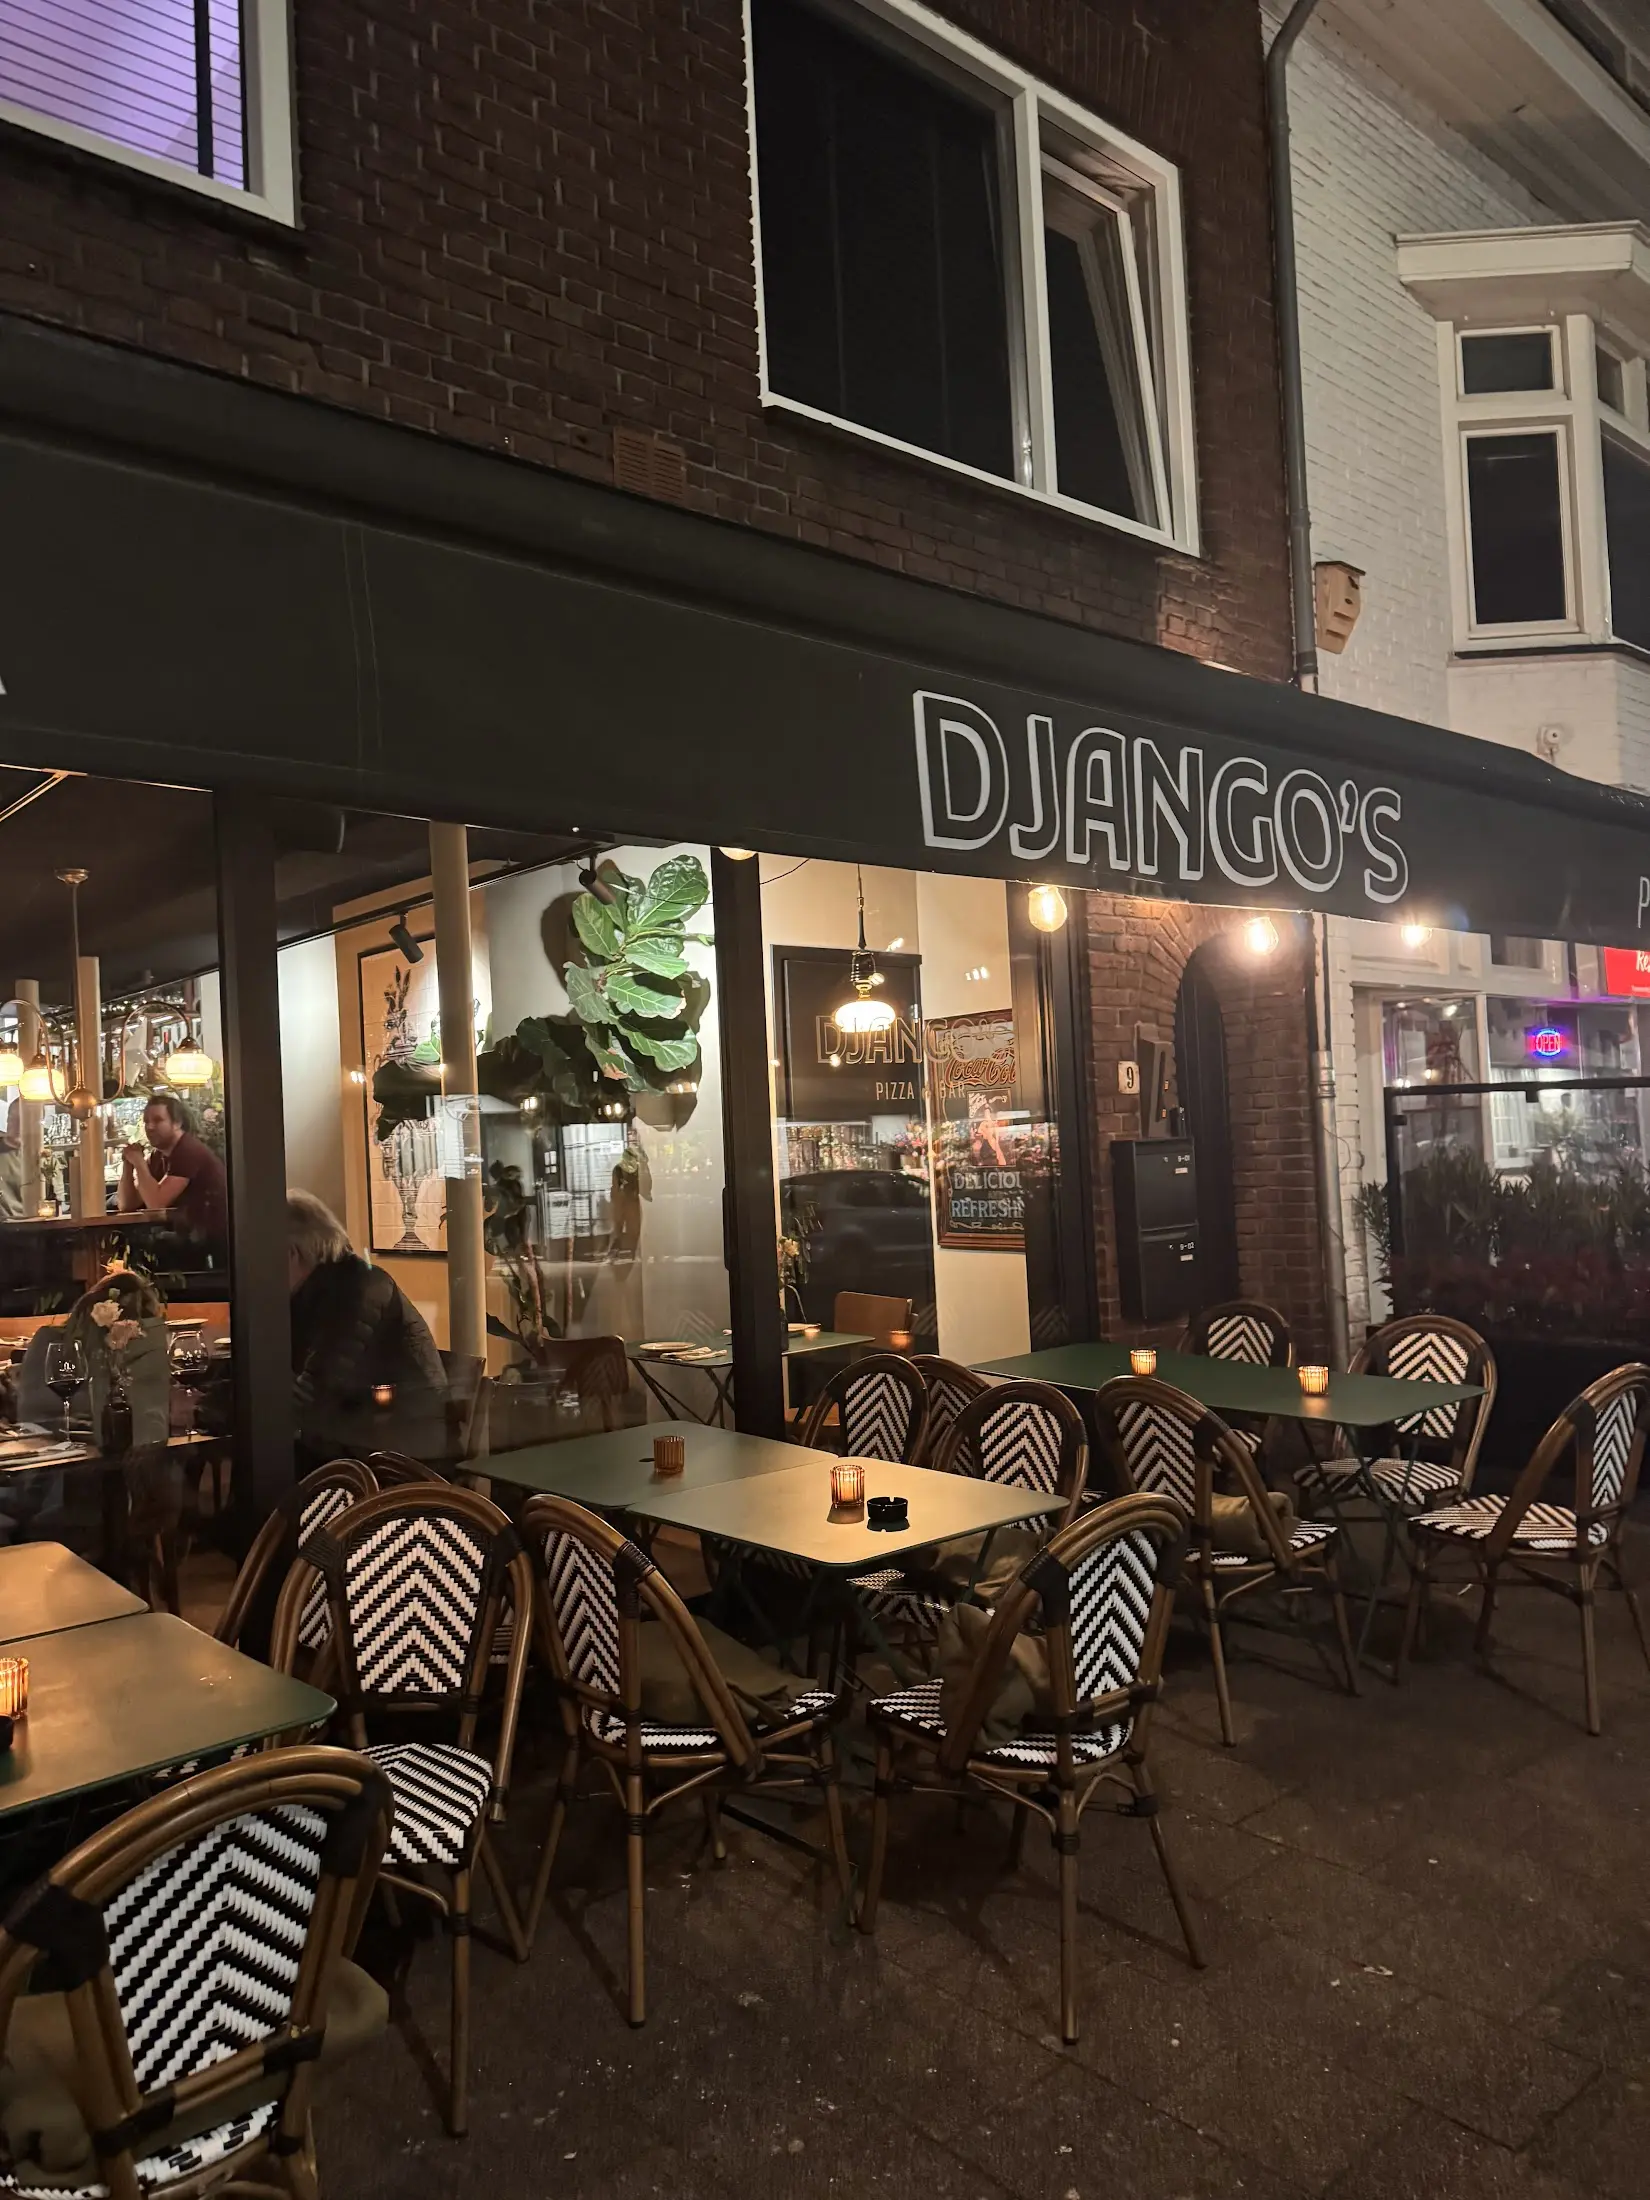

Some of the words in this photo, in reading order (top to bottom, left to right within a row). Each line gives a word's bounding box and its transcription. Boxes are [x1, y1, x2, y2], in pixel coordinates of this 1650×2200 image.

[913, 690, 1409, 904] DJANGO'S
[1537, 1034, 1562, 1052] OPEN
[945, 1046, 1017, 1088] Coca-Col
[1126, 1066, 1135, 1089] 9
[875, 1082, 915, 1100] PIZZA
[939, 1079, 966, 1099] BAR
